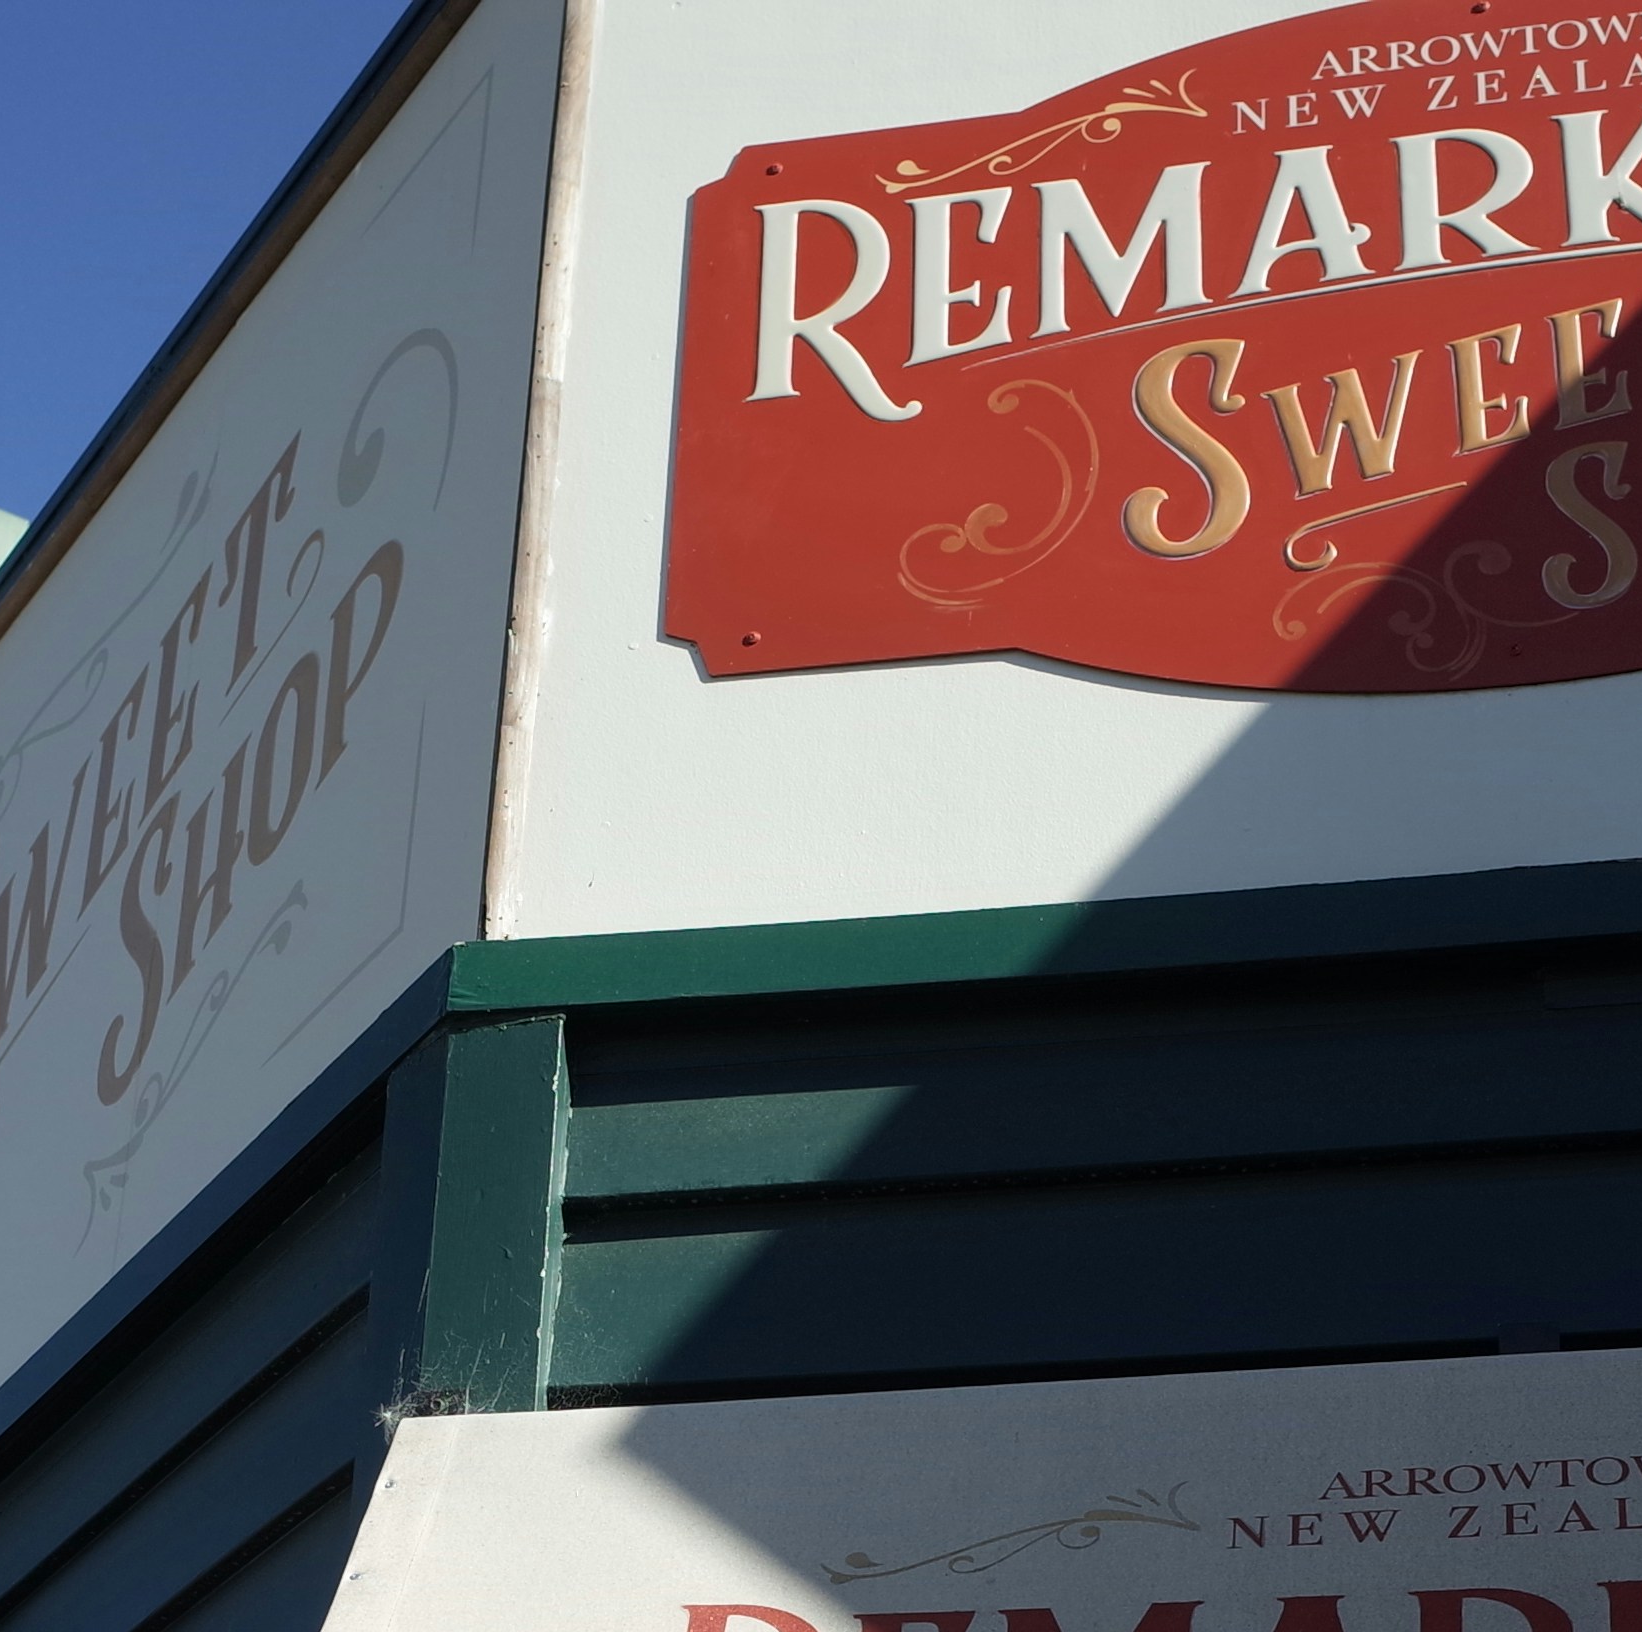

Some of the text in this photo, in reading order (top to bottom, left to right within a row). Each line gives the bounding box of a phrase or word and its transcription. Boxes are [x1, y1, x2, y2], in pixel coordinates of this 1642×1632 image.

[1231, 85, 1389, 137] NEW
[97, 540, 404, 1107] SHOP
[1224, 1506, 1395, 1552] NEW
